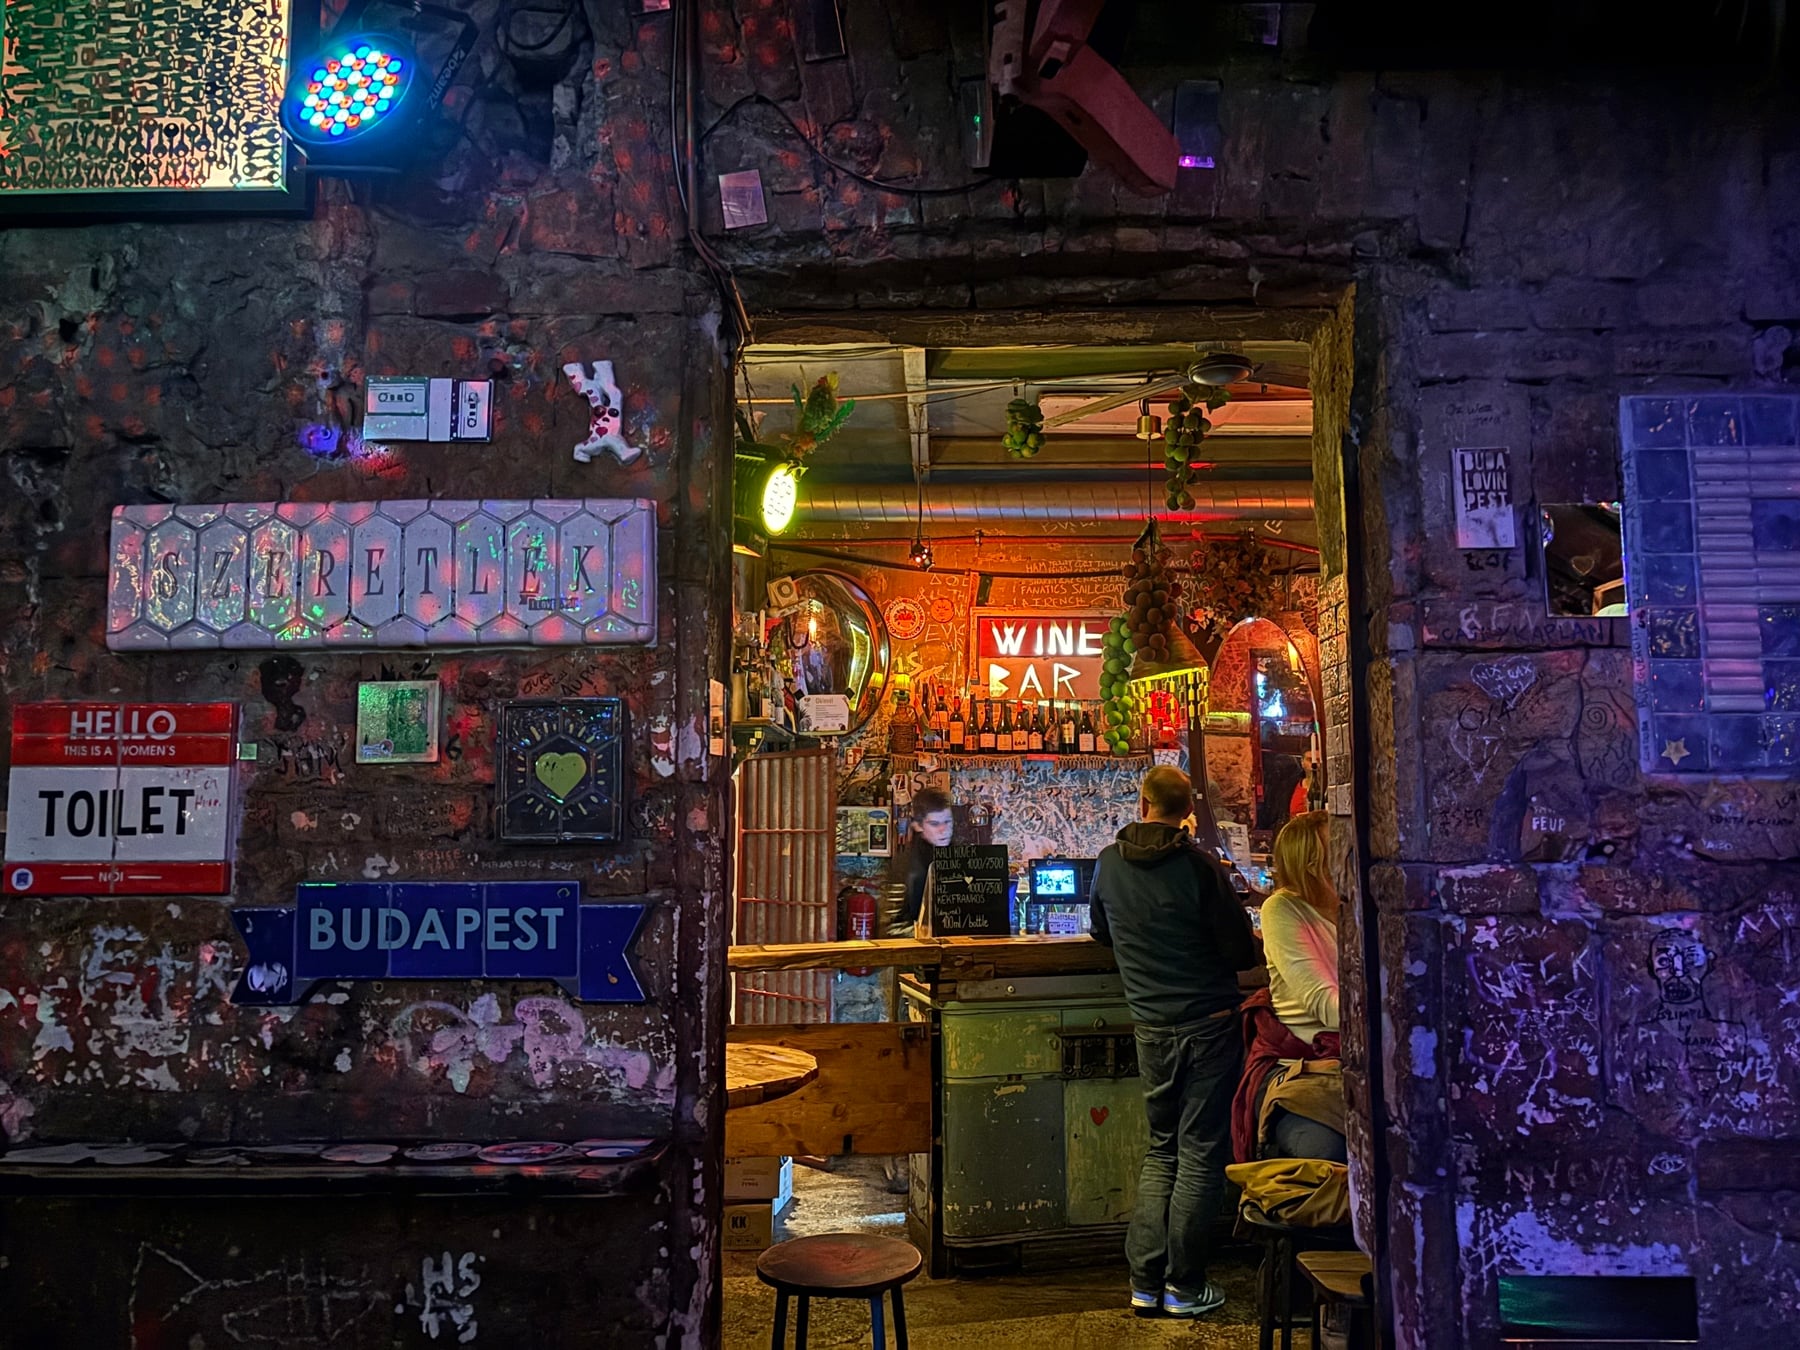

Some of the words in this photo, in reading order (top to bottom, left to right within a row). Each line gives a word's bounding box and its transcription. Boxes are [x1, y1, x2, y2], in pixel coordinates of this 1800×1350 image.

[1463, 451, 1507, 471] BUDA
[1464, 471, 1508, 491] LOVIN
[1465, 491, 1508, 511] PEST
[990, 619, 1103, 656] WINE
[988, 662, 1082, 699] BAR
[69, 709, 178, 741] HELLO
[63, 744, 89, 756] THIS
[90, 744, 102, 756] IS
[103, 744, 114, 756] A
[38, 786, 196, 838] TOILET
[308, 906, 564, 952] BUDAPEST
